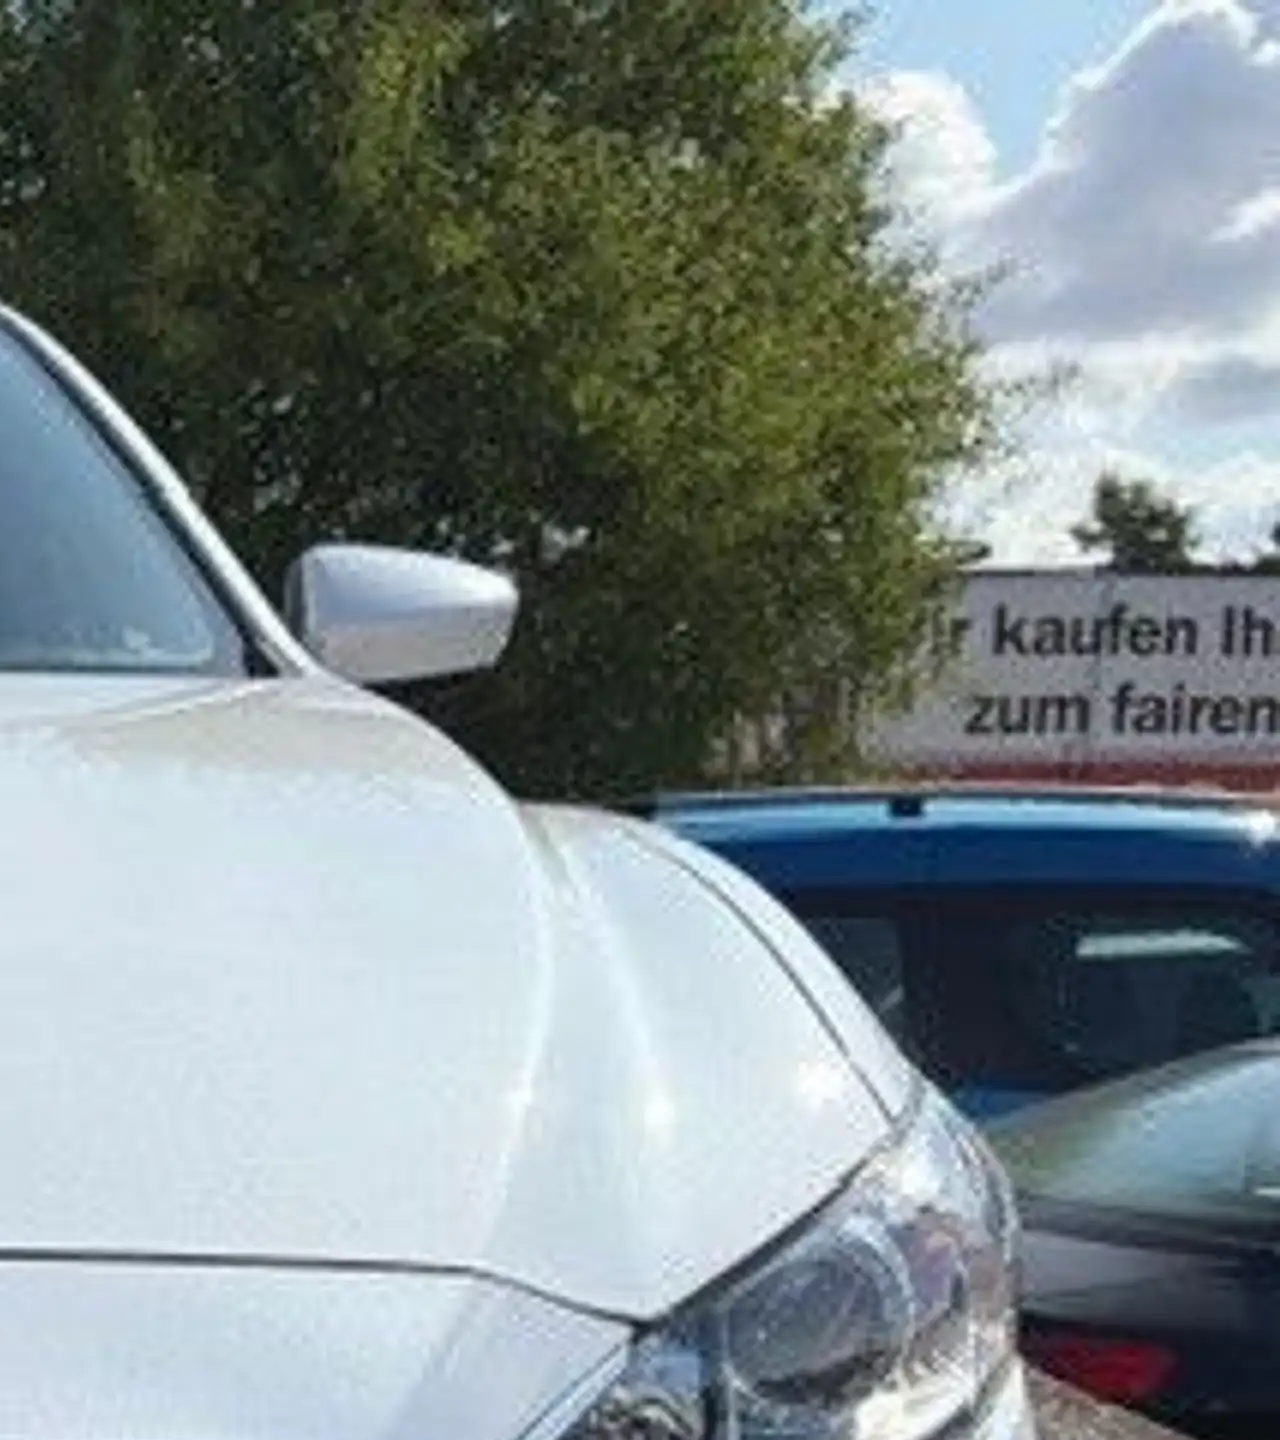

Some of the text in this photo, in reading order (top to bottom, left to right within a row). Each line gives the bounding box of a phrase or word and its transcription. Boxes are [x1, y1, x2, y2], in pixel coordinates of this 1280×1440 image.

[992, 603, 1198, 657] kaufen
[964, 681, 1280, 736] zum fairen
